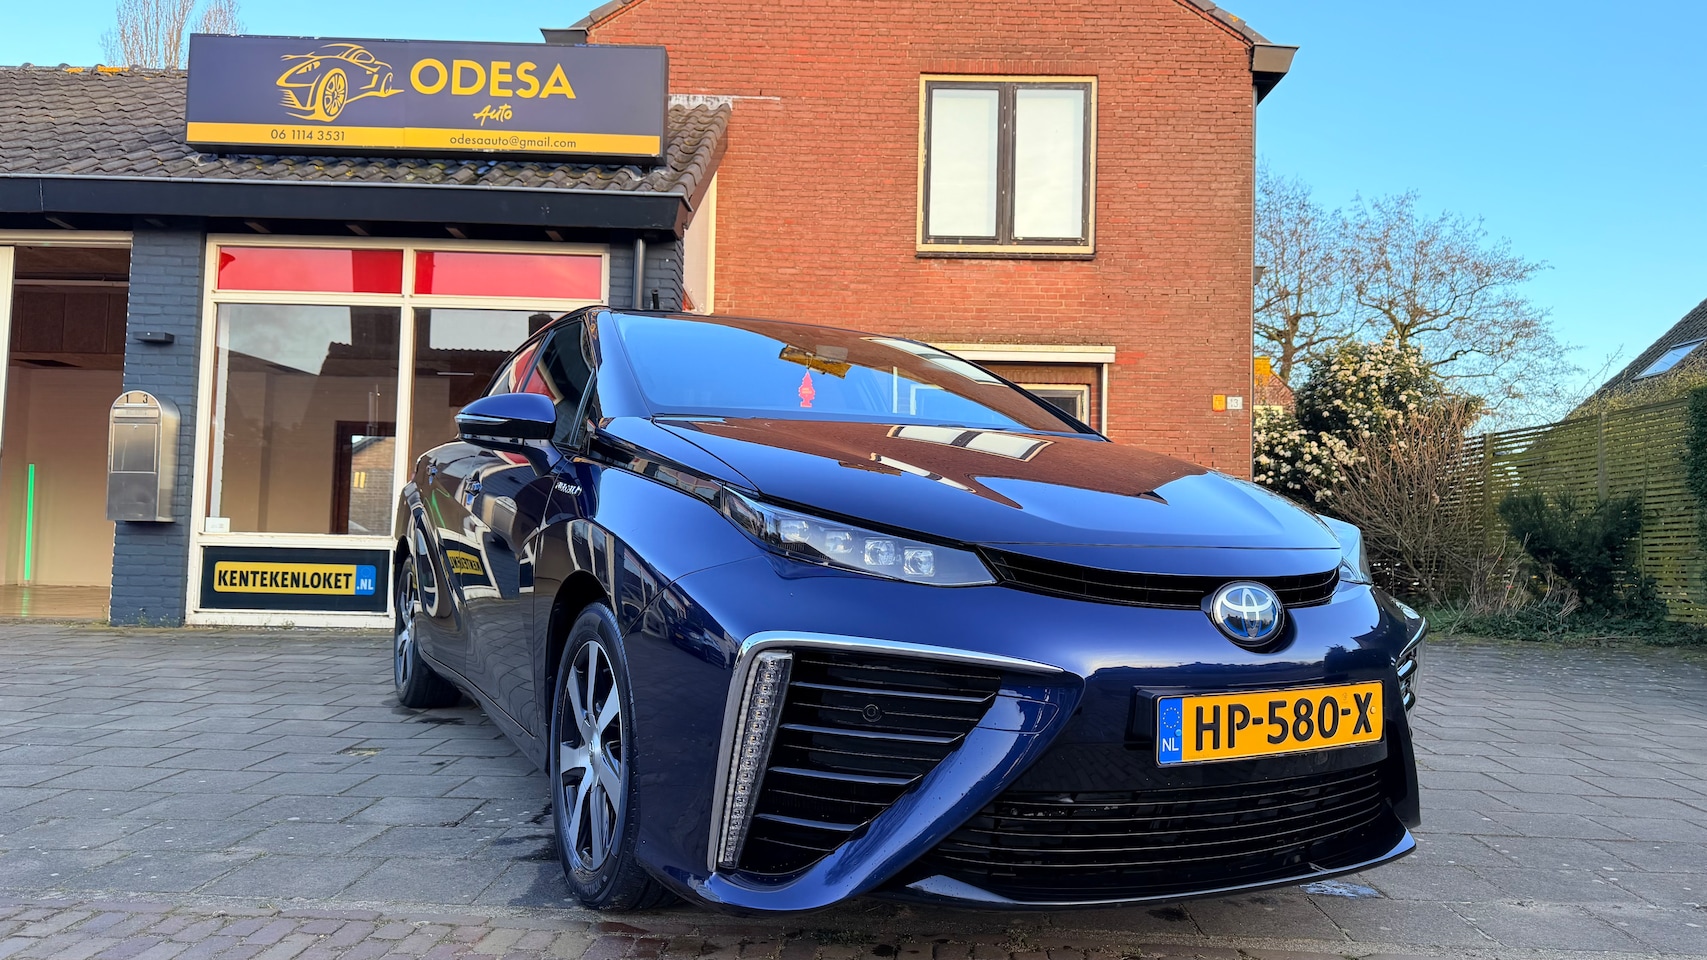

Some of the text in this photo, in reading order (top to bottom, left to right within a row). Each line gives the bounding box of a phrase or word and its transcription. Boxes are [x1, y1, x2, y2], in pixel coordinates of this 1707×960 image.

[410, 58, 577, 99] ODESA
[472, 103, 513, 127] Auto
[270, 129, 345, 142] 06 1114 3531
[449, 133, 577, 149] odesaauto@gmail.com
[1195, 692, 1373, 751] HP-580-X
[1162, 737, 1179, 753] NL
